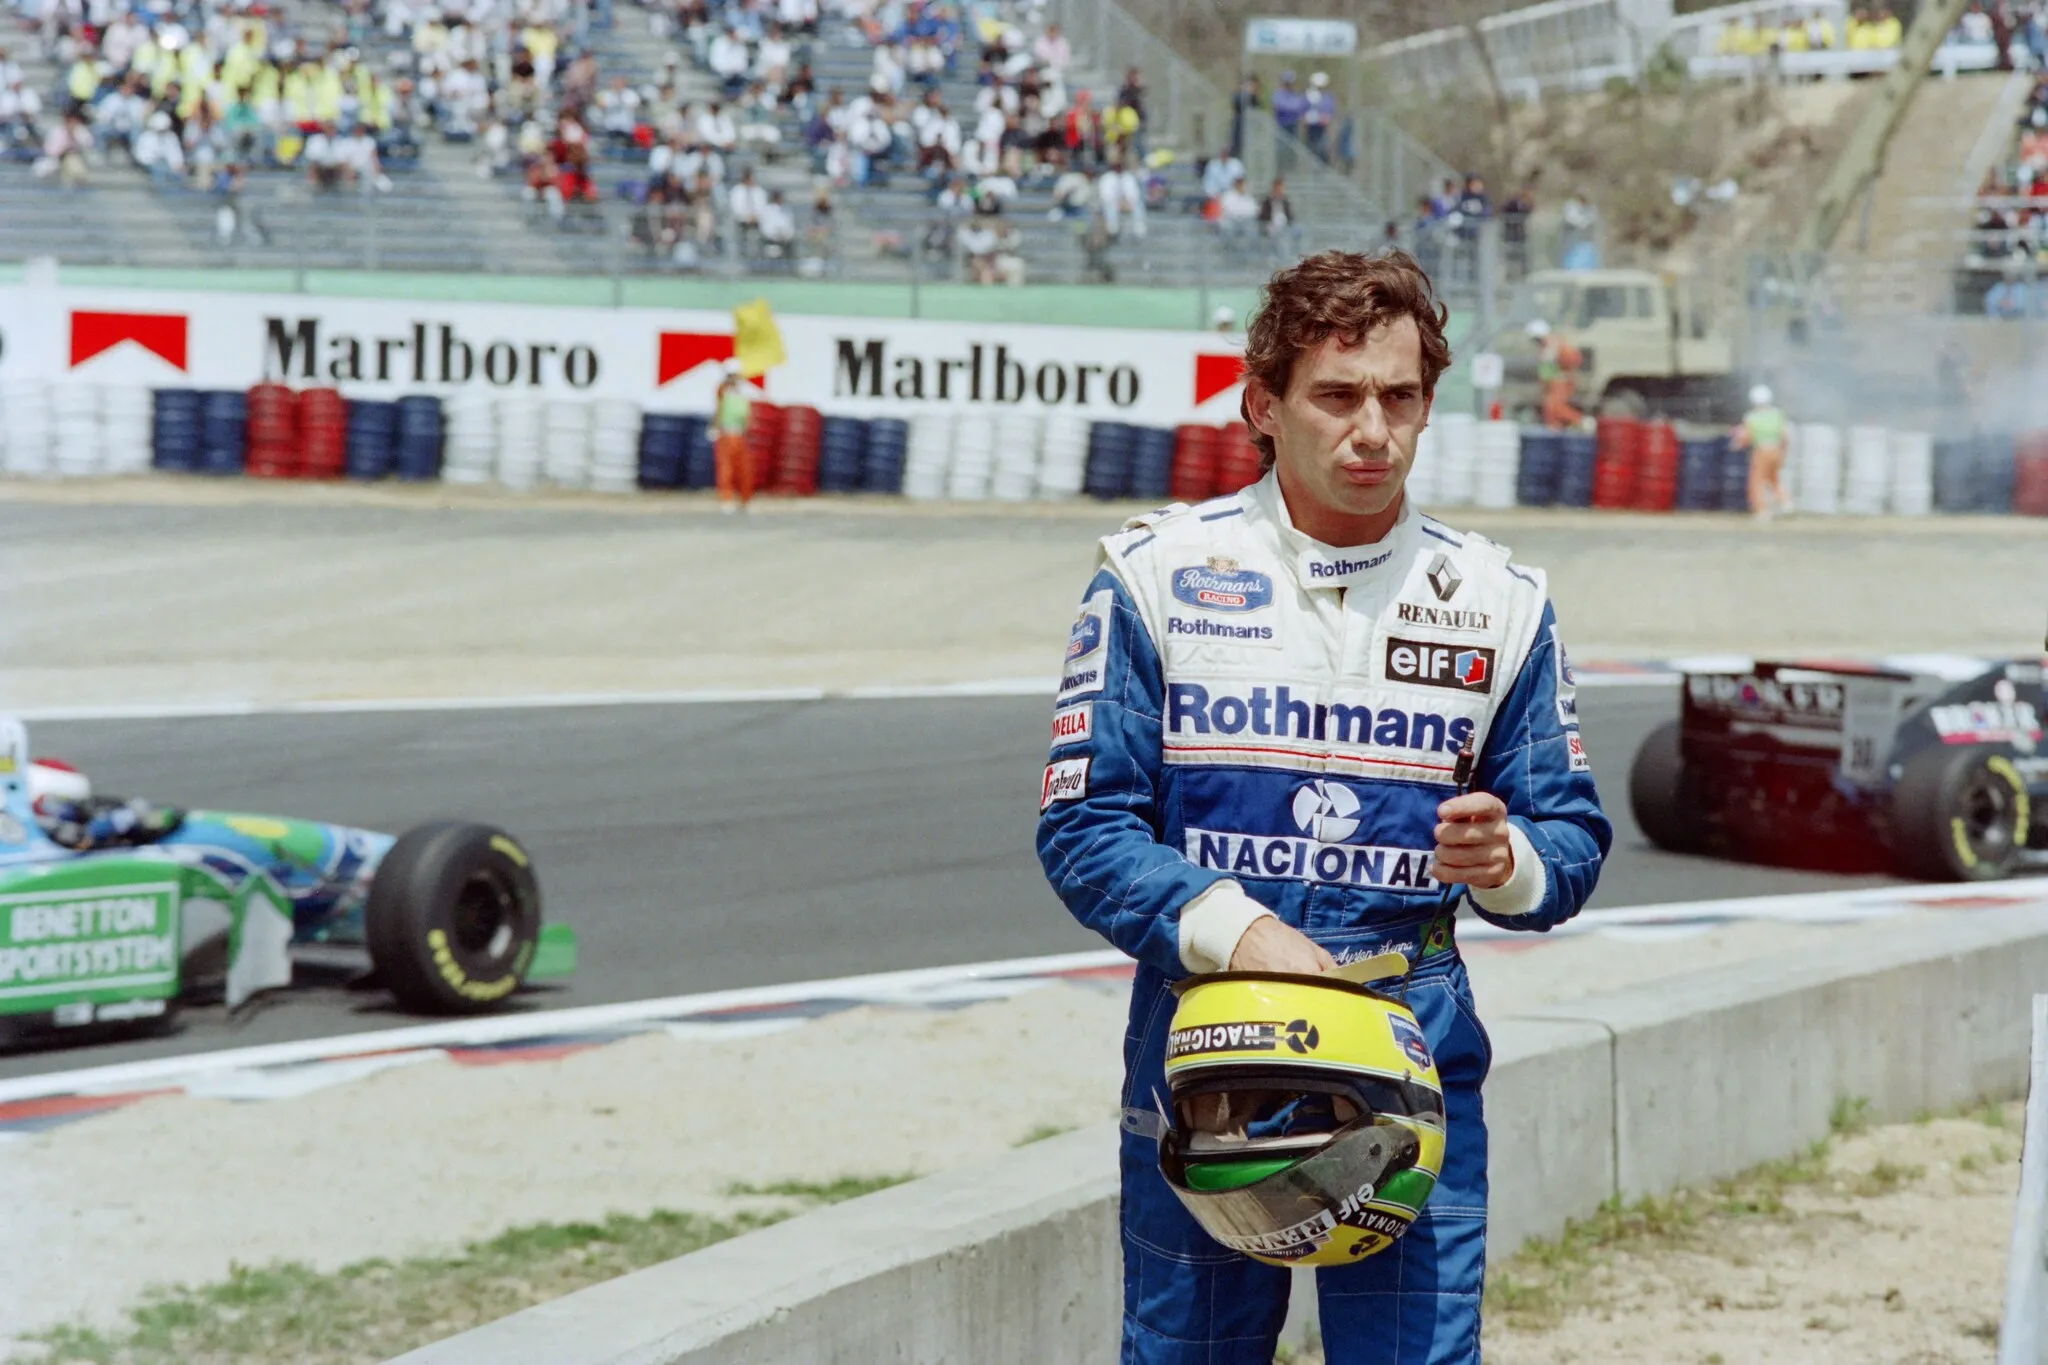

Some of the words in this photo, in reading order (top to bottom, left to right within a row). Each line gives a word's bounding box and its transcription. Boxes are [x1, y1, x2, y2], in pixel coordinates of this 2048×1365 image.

[264, 316, 599, 388] Marlboro
[833, 337, 1140, 405] Marlboro
[1310, 549, 1393, 577] Rothmans
[1180, 570, 1264, 592] Rothmans
[1203, 593, 1241, 604] RACING
[1168, 617, 1273, 639] Rothmans
[1397, 602, 1491, 629] RENAULT
[1391, 647, 1449, 679] elf
[1168, 683, 1475, 755] Rothmans
[1200, 834, 1430, 888] NACIONAL
[1339, 1183, 1374, 1220] elf
